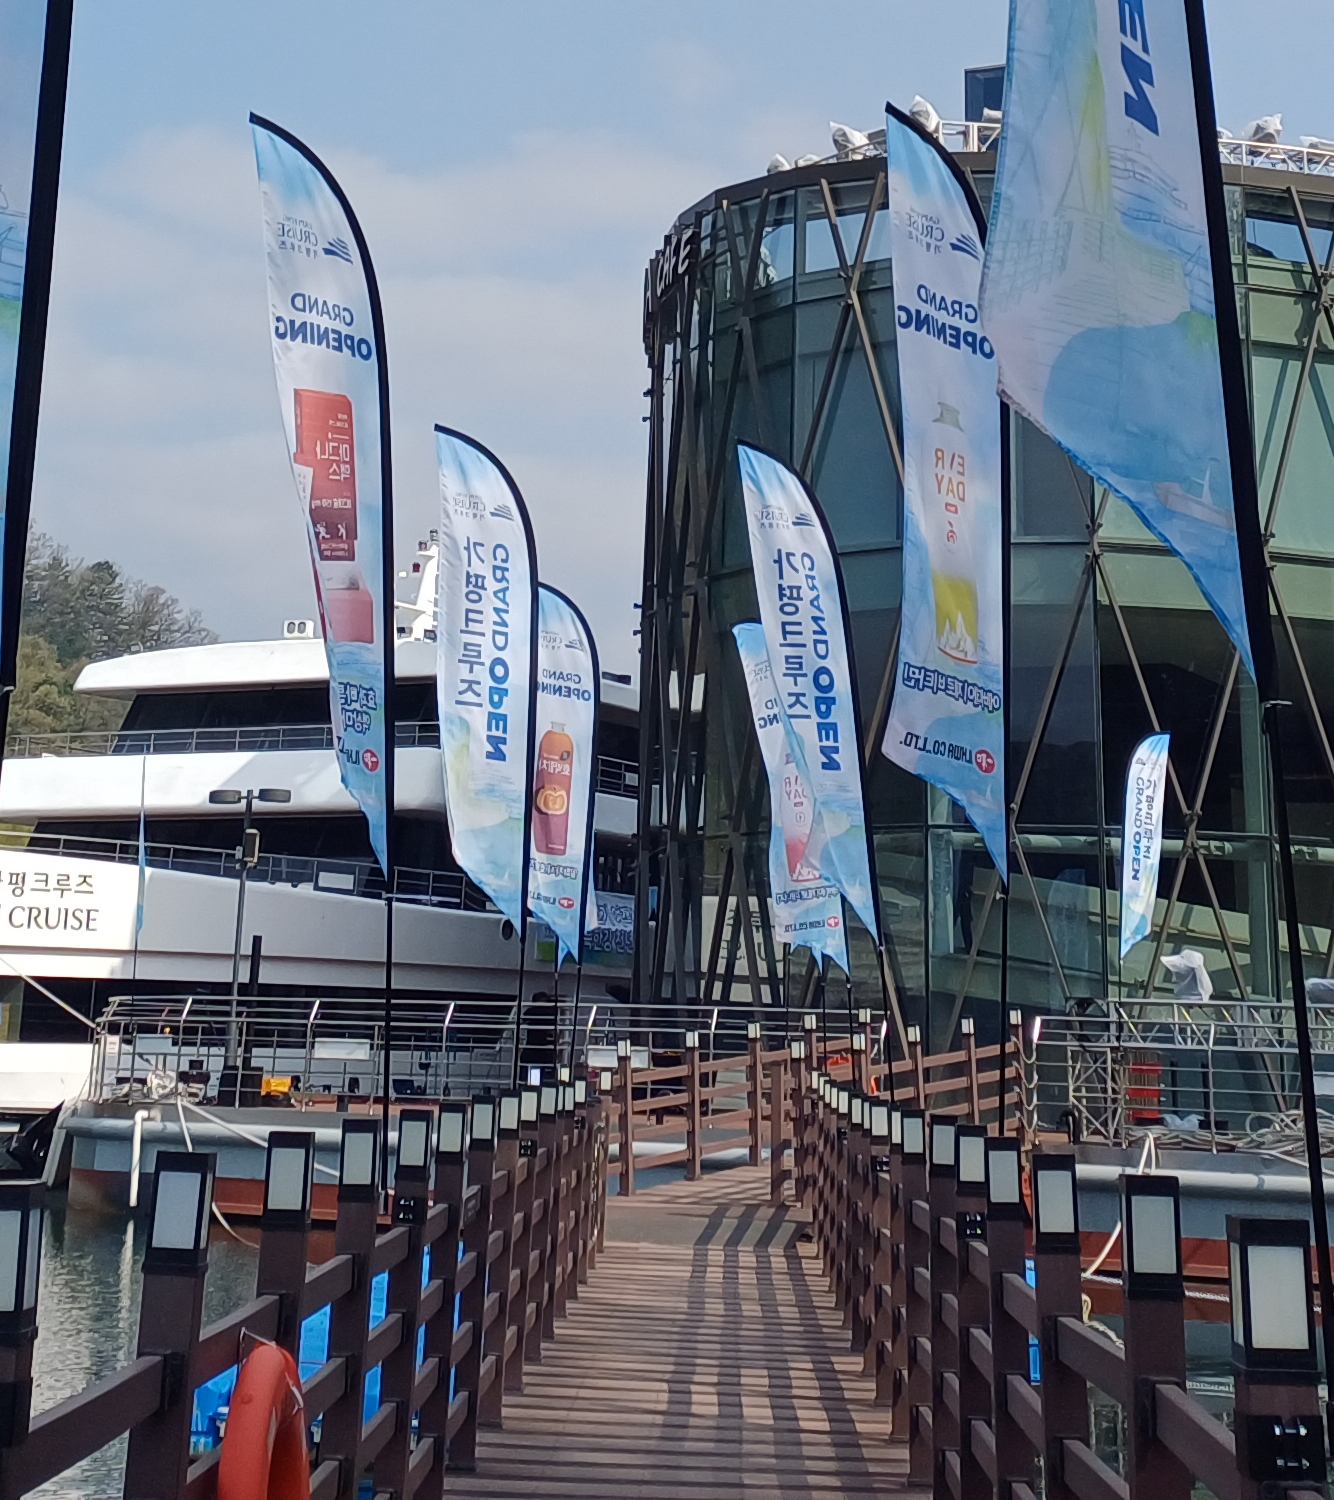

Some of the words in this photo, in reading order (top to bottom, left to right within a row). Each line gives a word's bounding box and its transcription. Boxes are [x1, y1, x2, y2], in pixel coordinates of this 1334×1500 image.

[1134, 776, 1145, 829] GRAND
[1131, 831, 1142, 881] OPEN
[8, 905, 100, 931] CRUISE
